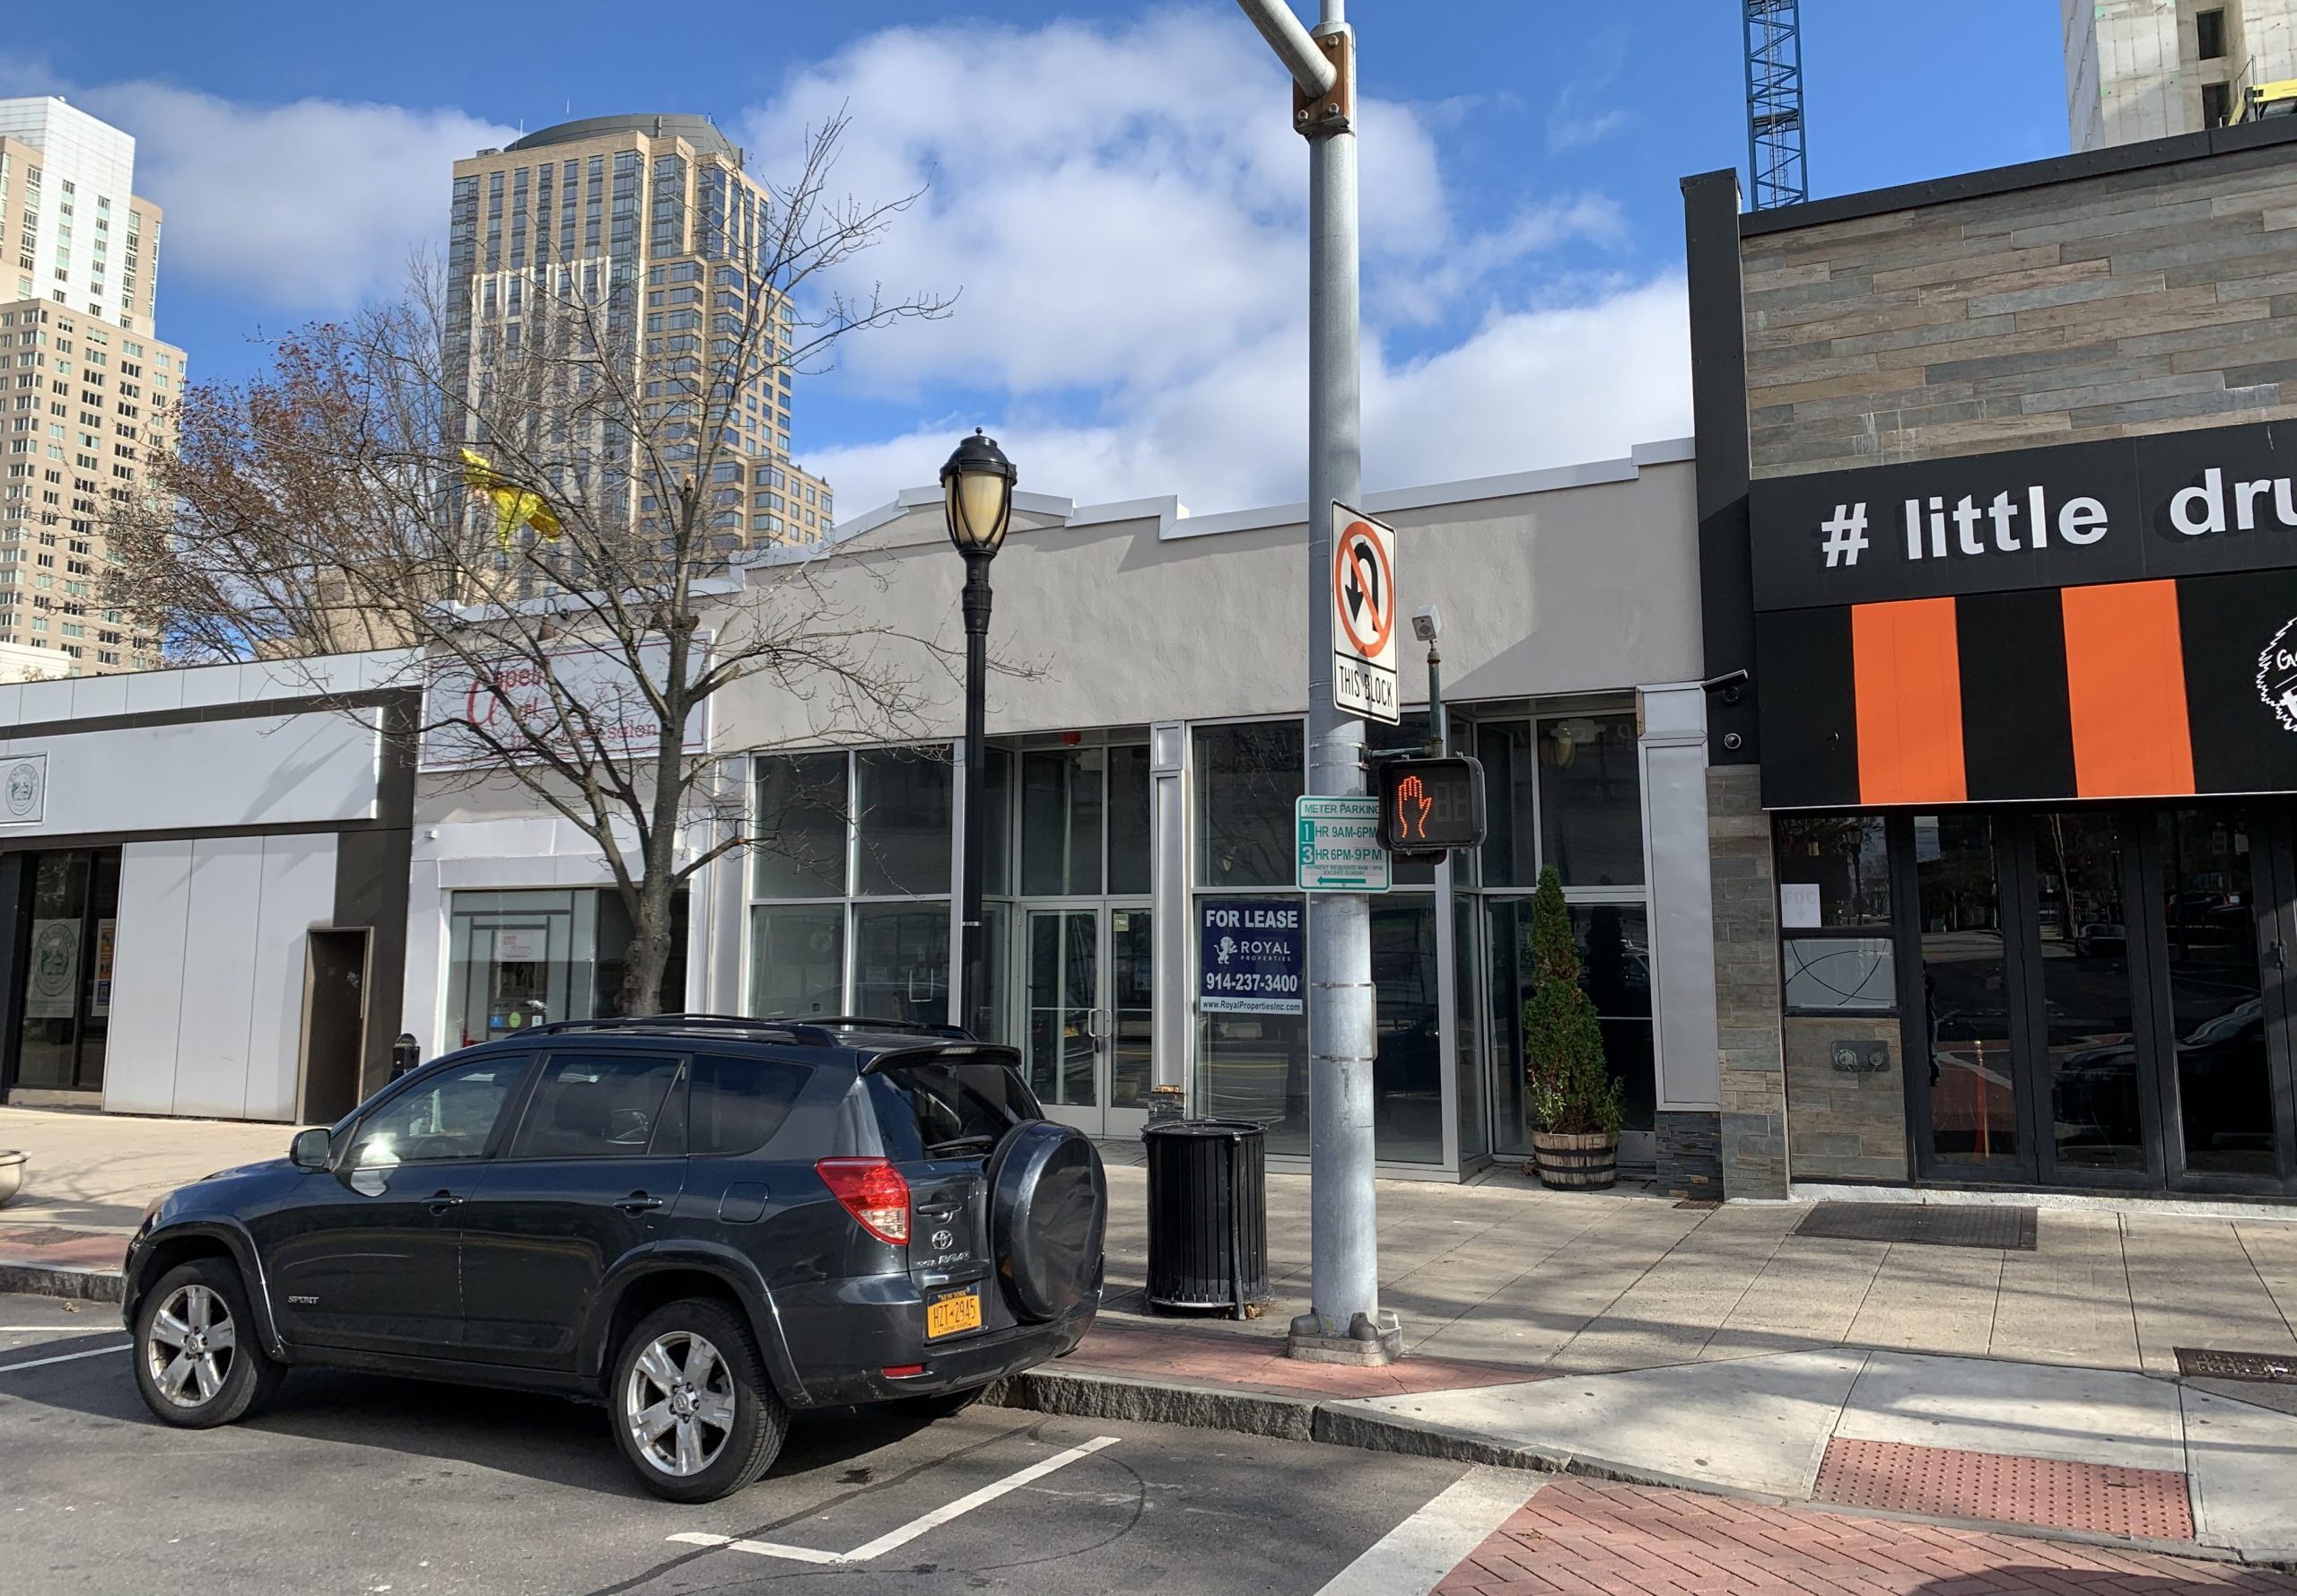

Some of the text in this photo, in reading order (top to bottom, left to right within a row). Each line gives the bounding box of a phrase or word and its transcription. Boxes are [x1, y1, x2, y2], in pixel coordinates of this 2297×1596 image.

[1904, 484, 2109, 560] little
[1340, 665, 1393, 709] THIS BLOCK
[1304, 804, 1337, 814] METER
[1304, 823, 1309, 842] 1
[1315, 826, 1329, 838] HR
[1302, 846, 1314, 864] 3
[1315, 849, 1329, 860] HR
[1206, 910, 1298, 929] FOR LEASE
[1241, 941, 1291, 955] ROYAL
[1206, 972, 1297, 992] 914-237-3400
[1202, 999, 1301, 1012] www.RoyalPropertiesInc.com
